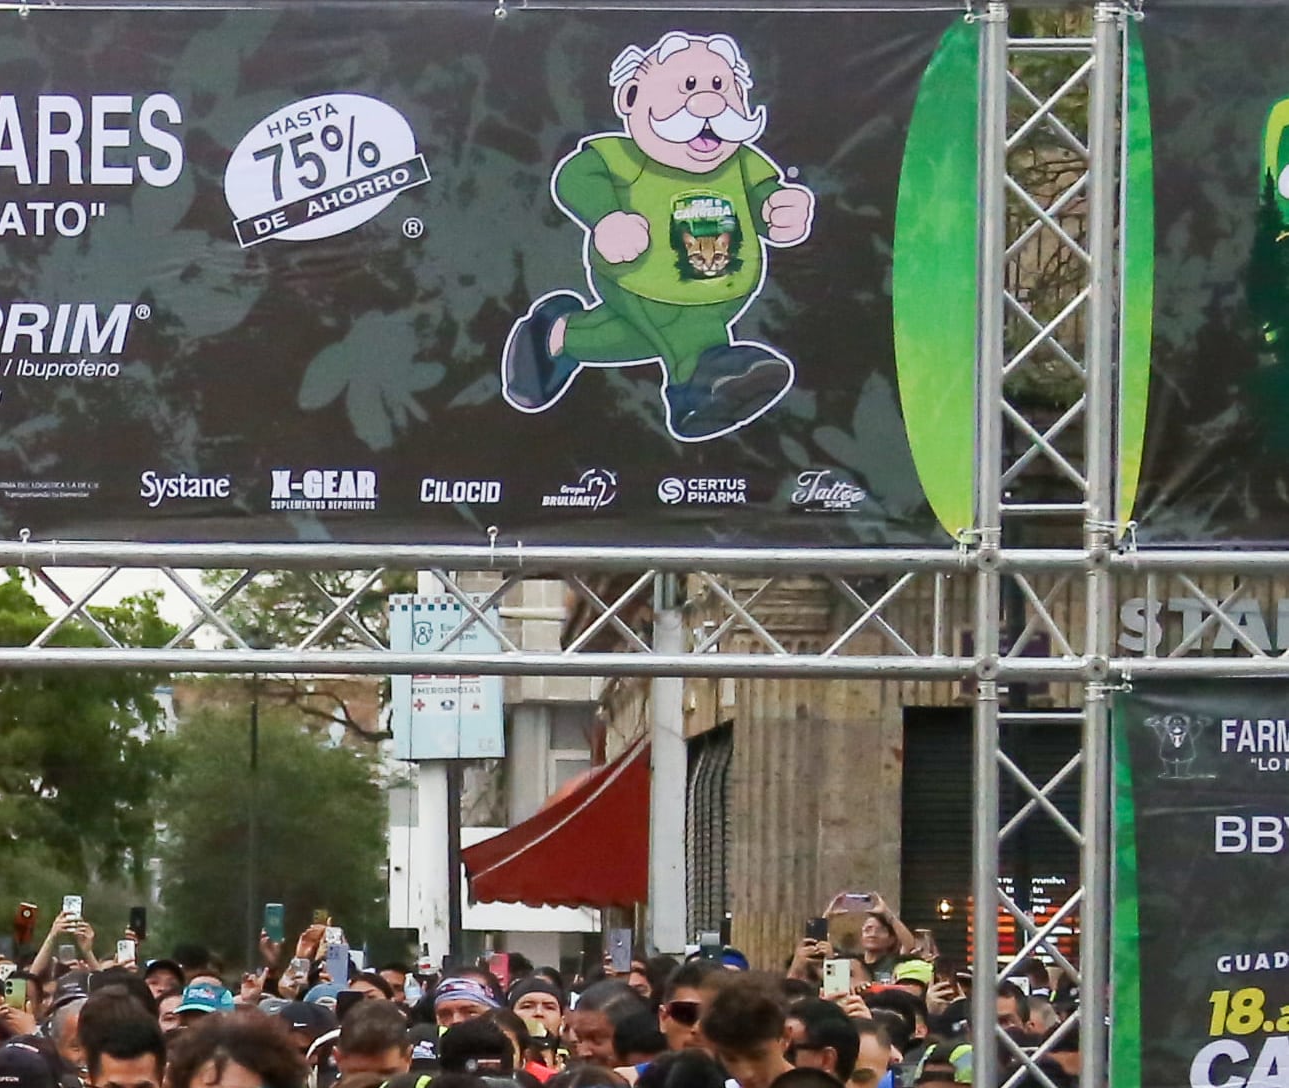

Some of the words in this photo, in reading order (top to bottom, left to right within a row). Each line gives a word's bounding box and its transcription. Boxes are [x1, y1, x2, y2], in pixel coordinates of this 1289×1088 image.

[266, 102, 339, 138] HASTA
[252, 115, 381, 202] 75%
[253, 211, 289, 235] DE
[306, 168, 410, 217] AHORRO
[3, 359, 12, 377] /
[17, 359, 119, 380] Ibuprofeno
[140, 470, 230, 508] Systane
[271, 470, 377, 499] X-GEAR
[421, 478, 502, 504] CILOCID
[688, 478, 746, 490] CERTUS
[688, 491, 746, 503] PHARMA
[1118, 597, 1289, 651] STA
